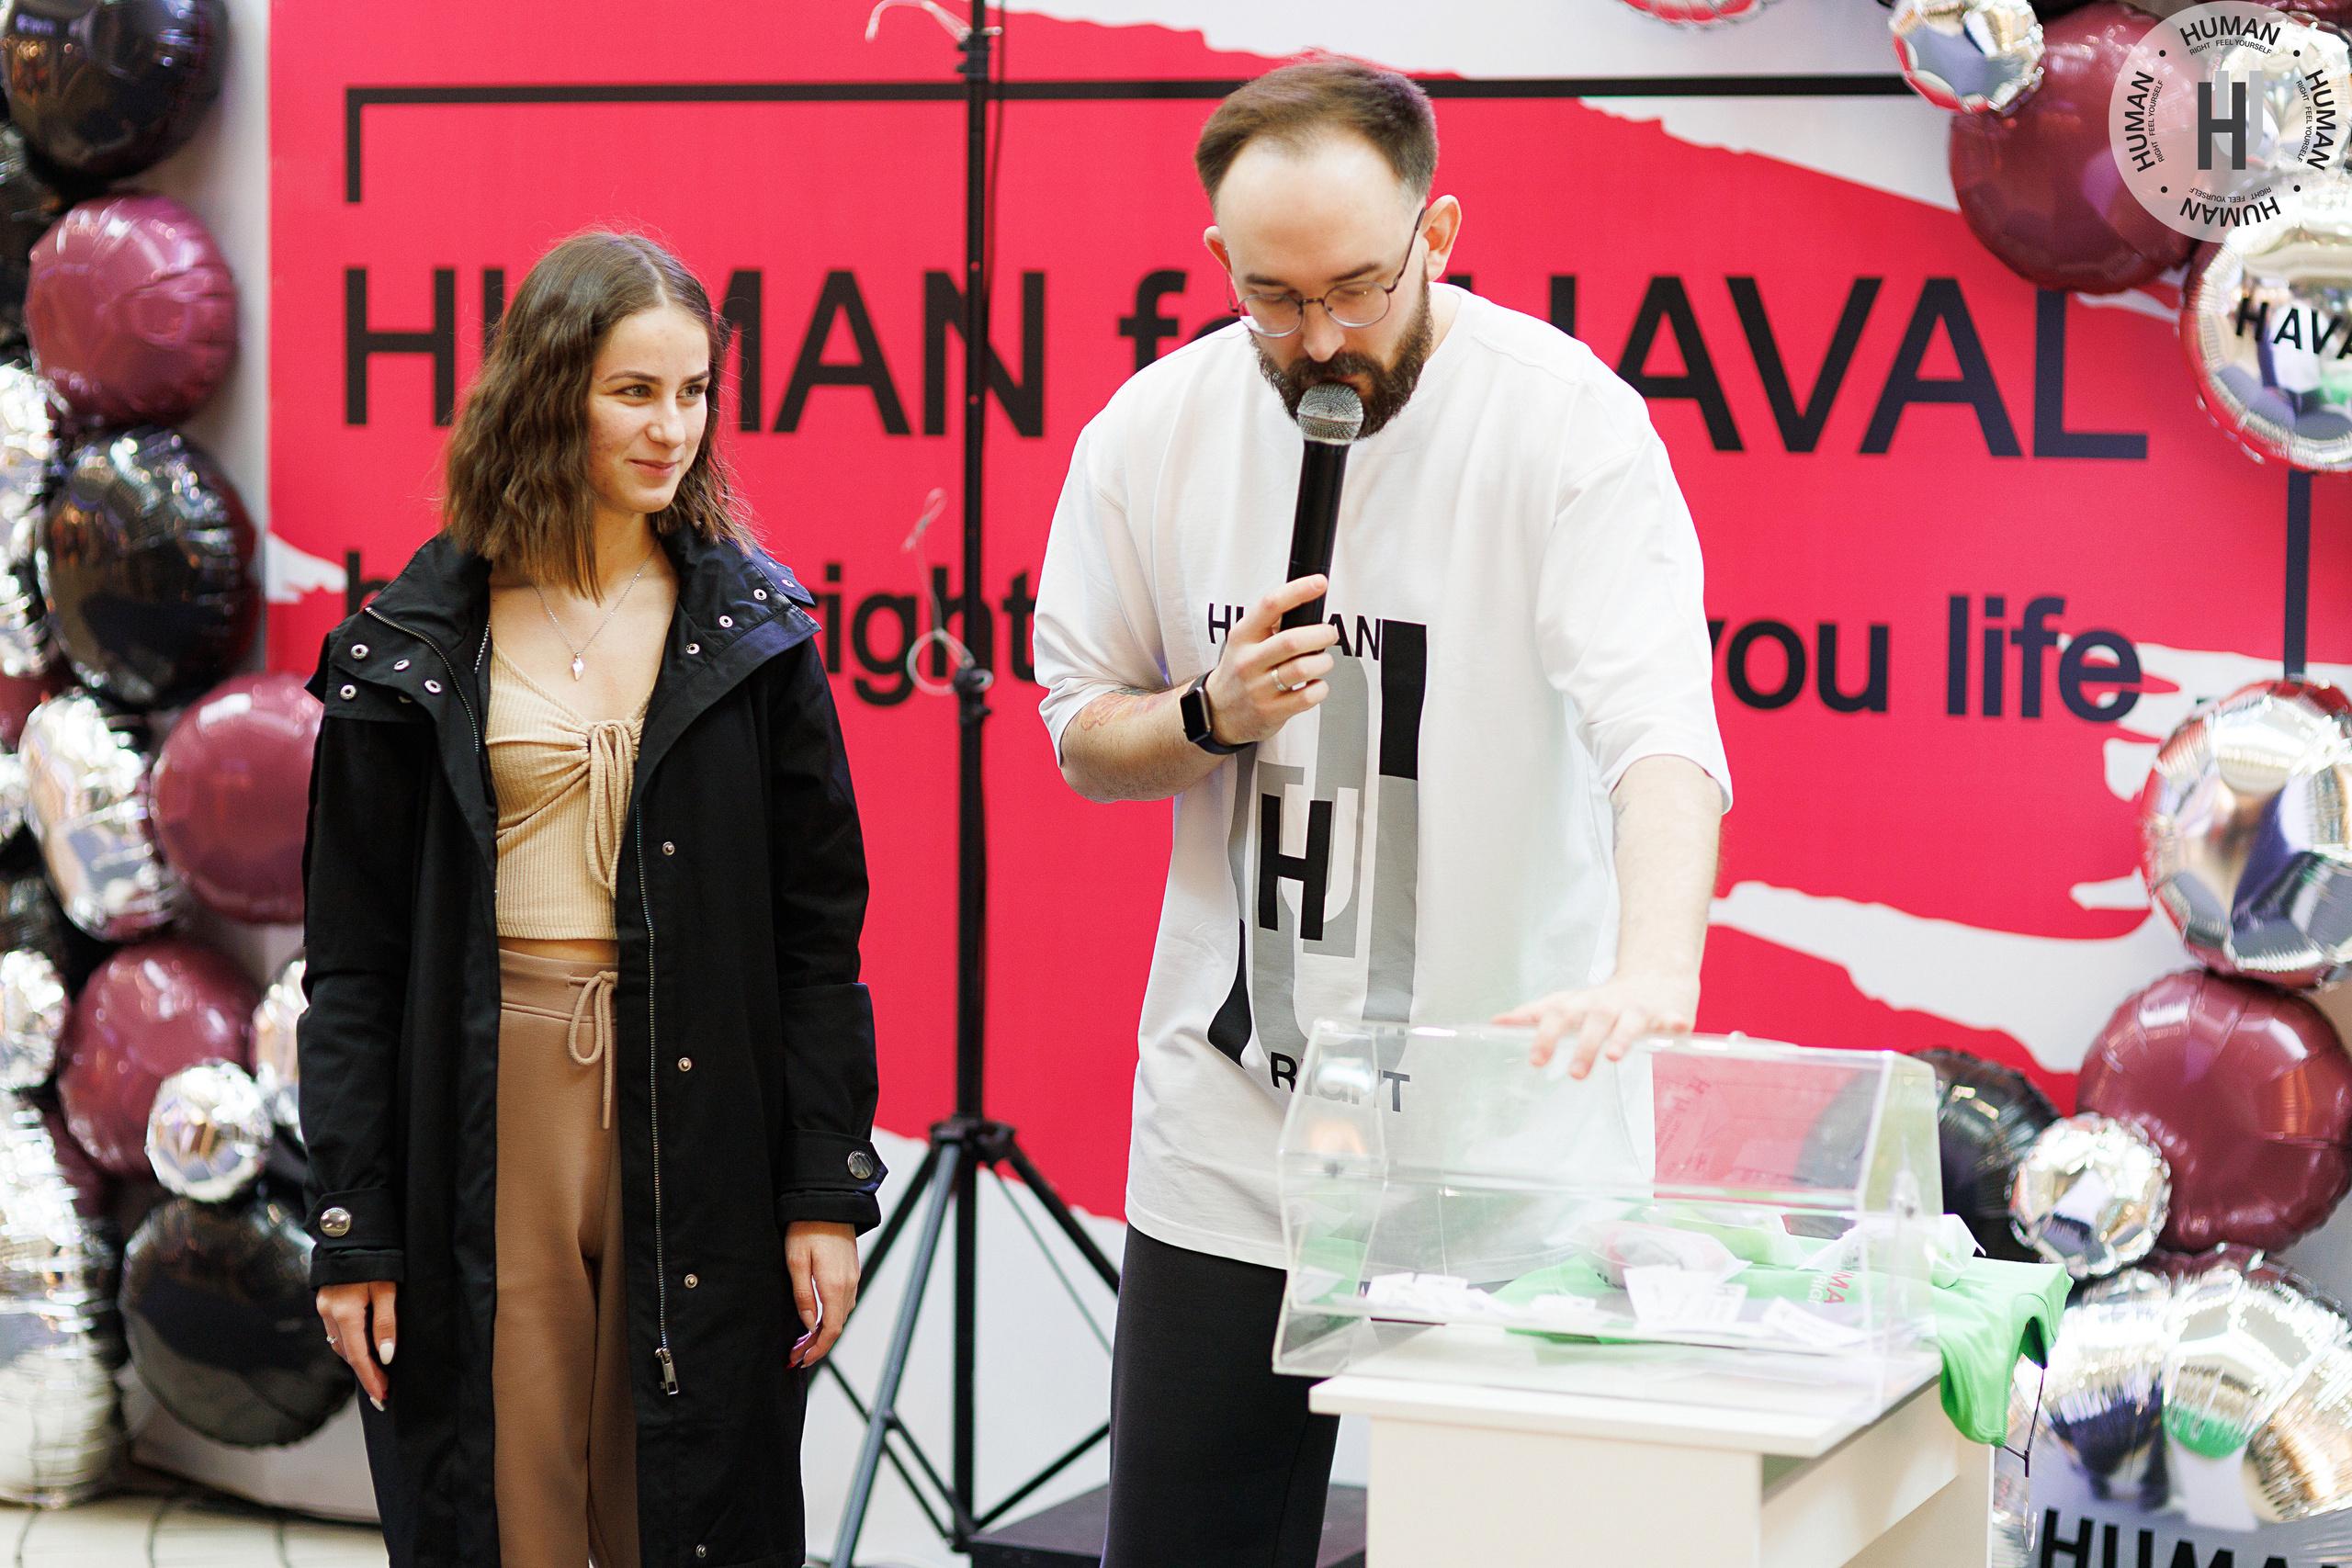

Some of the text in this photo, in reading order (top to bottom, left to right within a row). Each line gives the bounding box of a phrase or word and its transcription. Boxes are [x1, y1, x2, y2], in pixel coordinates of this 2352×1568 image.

[345, 266, 1046, 438] HAN
[1447, 273, 2149, 461] AVAL
[802, 562, 2143, 723] ight ou life
[1207, 603, 1380, 661] HAN
